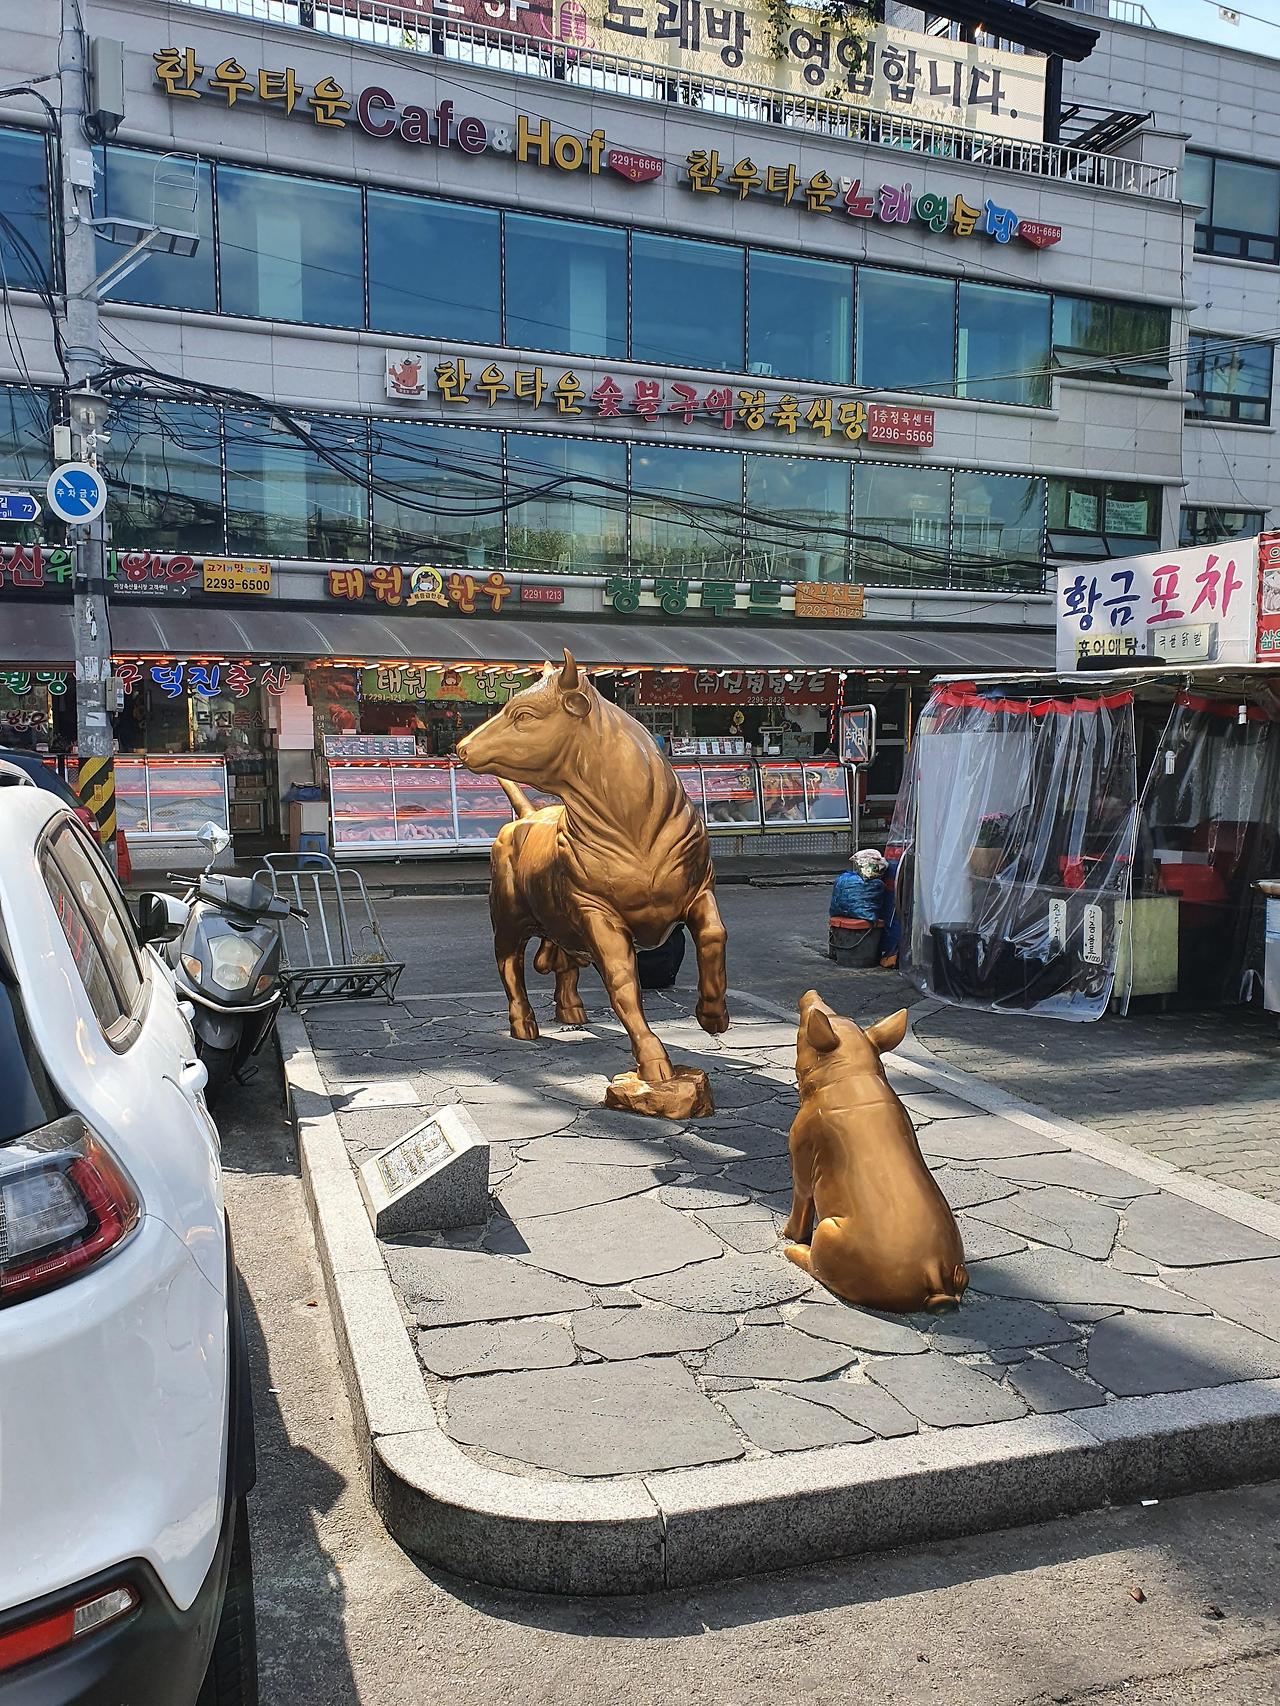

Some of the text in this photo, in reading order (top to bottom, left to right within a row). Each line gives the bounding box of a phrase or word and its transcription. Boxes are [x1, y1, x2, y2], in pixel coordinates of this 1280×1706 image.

[603, 0, 1018, 119] 노래방 영업합니다.
[153, 46, 606, 175] 한우타운 Cafe & Hof
[611, 152, 662, 173] 2291-6666
[629, 167, 643, 180] 3F
[1021, 222, 1062, 240] 2291-6666
[433, 358, 586, 415] 한우타운
[872, 425, 933, 443] 2296-5566
[56, 487, 98, 499] 주차금지
[22, 504, 33, 513] 72
[206, 577, 271, 591] 2293-6500
[328, 566, 512, 614] 태원 한우
[523, 588, 562, 600] 2291 1213
[1062, 553, 1243, 631] 황금포차
[605, 577, 783, 615] 청정푸드
[150, 664, 292, 699] 덕진축산
